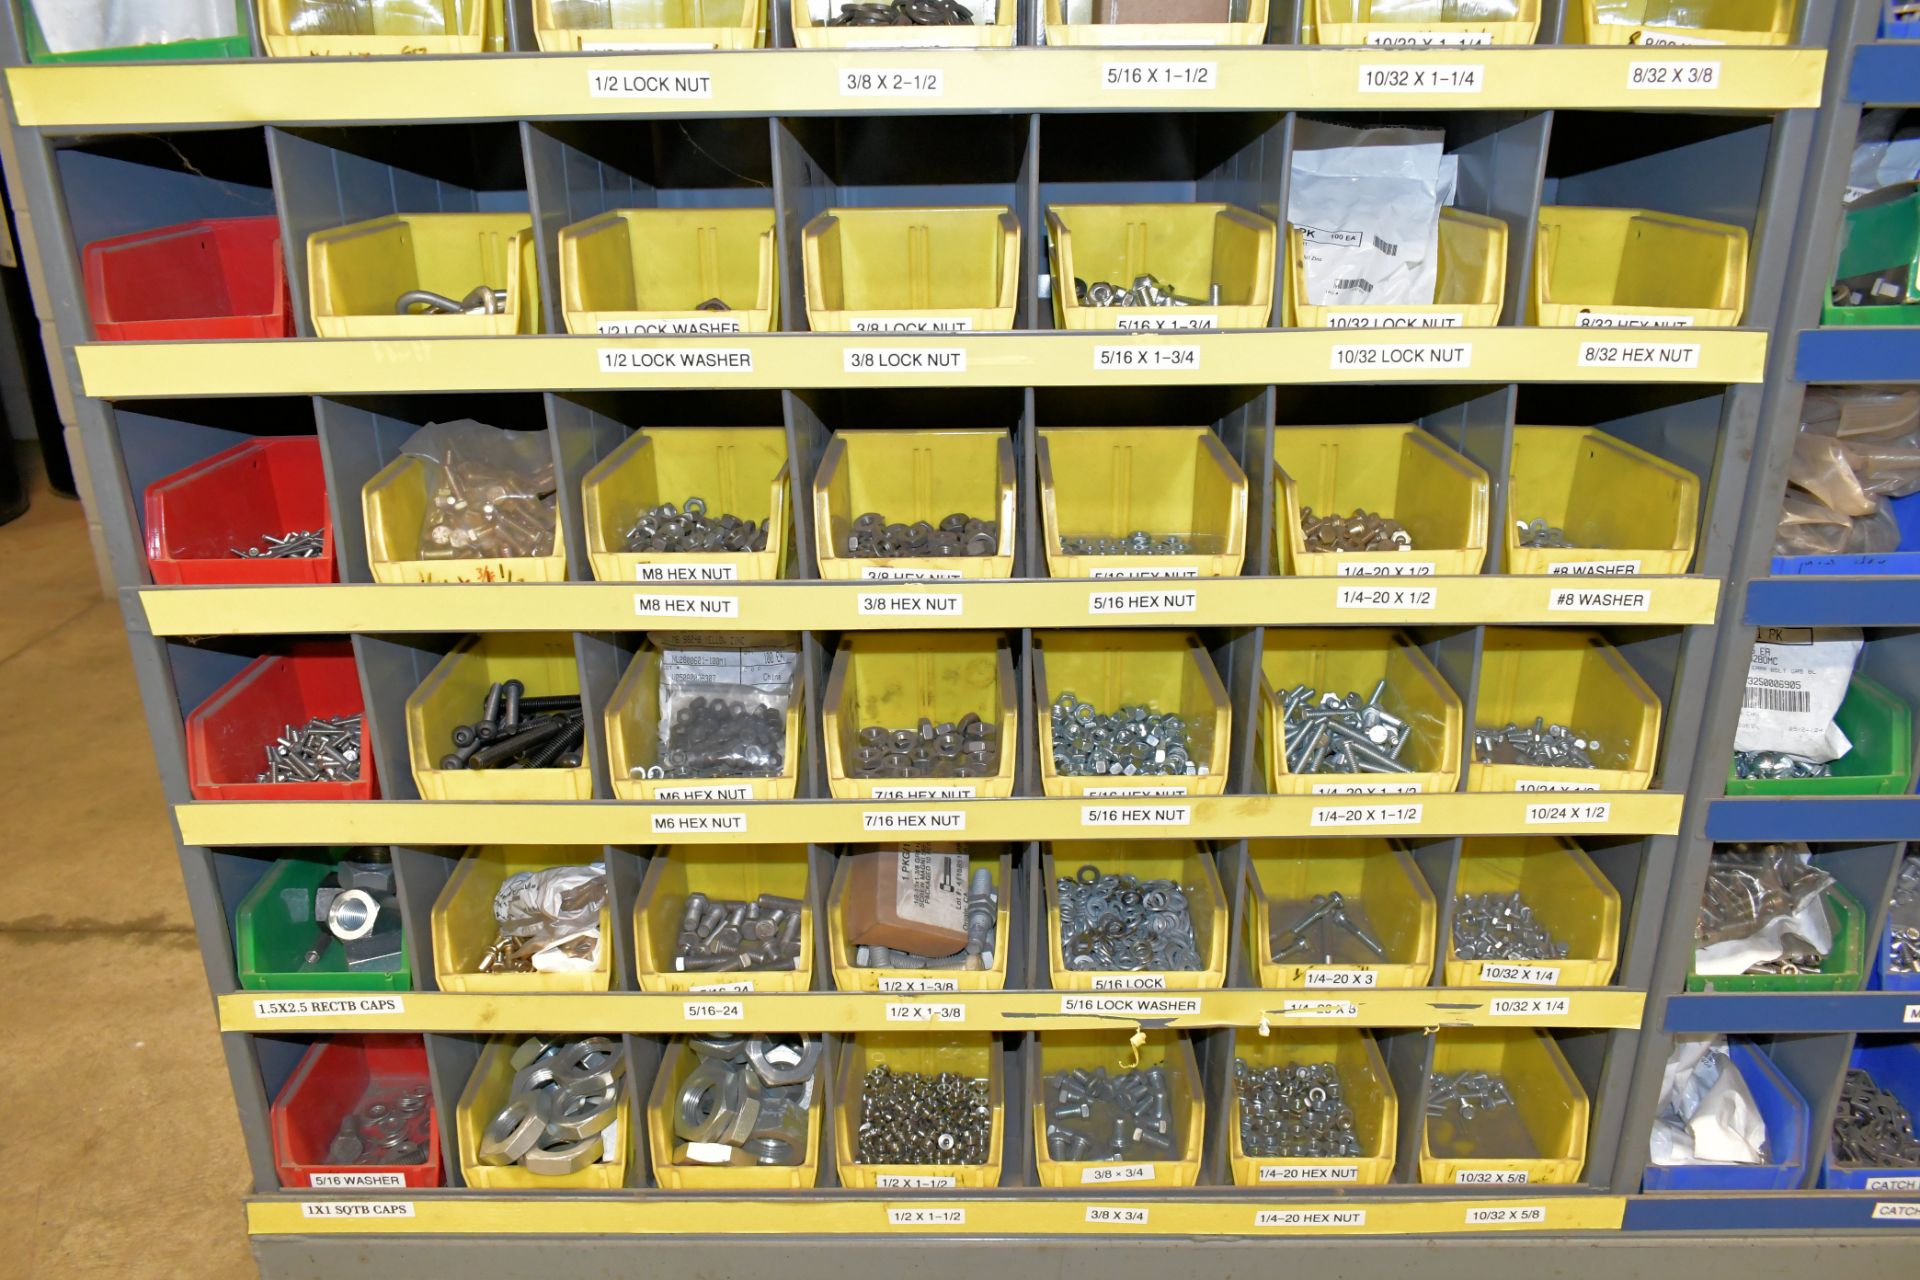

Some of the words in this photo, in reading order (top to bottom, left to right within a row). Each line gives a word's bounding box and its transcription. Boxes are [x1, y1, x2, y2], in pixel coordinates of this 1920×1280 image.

[1107, 68, 1142, 83] 5/16
[1147, 69, 1158, 83] X
[1165, 68, 1208, 83] 1-1/2
[1366, 71, 1409, 86] 10/32
[1414, 71, 1425, 86] X
[1432, 71, 1474, 86] 1-1/4
[1633, 67, 1667, 83] 8/32
[1672, 68, 1683, 82] X
[1688, 67, 1713, 83] 3/8
[595, 76, 618, 91] 1/2
[623, 76, 670, 91] LOCK
[675, 77, 710, 92] NUT
[847, 74, 871, 90] 3/8
[877, 75, 888, 89] X
[893, 75, 937, 90] 2-1/2
[605, 354, 627, 367] 1/2
[632, 353, 676, 367] LOCK
[680, 353, 750, 367] WASHER
[851, 353, 874, 367] 3/8
[879, 353, 922, 366] LOCK
[928, 353, 960, 366] NUT
[1101, 351, 1132, 364] 5/16
[1138, 351, 1147, 363] X
[1154, 351, 1194, 364] 1-3/4
[1338, 350, 1376, 363] 10/32
[1382, 349, 1424, 363] LOCK
[1431, 349, 1464, 362] NUT
[1586, 348, 1618, 361] 8/32
[1622, 349, 1655, 361] HEX
[1659, 349, 1692, 362] NUT
[643, 568, 663, 580] M8
[668, 568, 697, 580] HEX
[702, 568, 731, 580] NUT
[1573, 565, 1635, 575] WASHER
[1094, 597, 1124, 609] 5/16
[1128, 596, 1159, 608] HEX
[1164, 595, 1195, 607] NUT
[1343, 592, 1390, 604] 1/4-20
[1394, 592, 1404, 604] X
[1410, 592, 1431, 604] 1/2
[1557, 594, 1574, 606] #8
[1578, 594, 1644, 606] WASHER
[640, 599, 660, 611] M8
[666, 600, 695, 612] HEX
[701, 601, 731, 612] NUT
[864, 598, 886, 610] 3/8
[891, 598, 921, 610] HEX
[926, 599, 957, 610] NUT
[1769, 628, 1783, 641] PK
[660, 791, 679, 800] M6
[684, 790, 713, 800] HEX
[718, 789, 746, 800] NUT
[1089, 811, 1117, 821] 5/16
[1122, 811, 1151, 820] HEX
[1155, 810, 1185, 820] NUT
[1318, 810, 1362, 821] 1/4-20
[1367, 810, 1375, 820] X
[1381, 808, 1416, 820] 1-1/2
[1532, 808, 1566, 819] 10/24
[1571, 808, 1580, 818] X
[1586, 807, 1605, 818] 1/2
[655, 818, 674, 829] M6
[679, 818, 707, 828] HEX
[712, 817, 741, 828] NUT
[865, 816, 893, 826] 7/16
[898, 816, 926, 826] HEX
[931, 816, 960, 826] NUT
[1308, 973, 1348, 984] 1/4-20
[1353, 975, 1361, 984] X
[1365, 975, 1373, 984] 3
[1486, 968, 1518, 979] 10/32
[1522, 971, 1531, 980] X
[1535, 970, 1553, 981] 1/4
[884, 981, 902, 991] 1/2
[907, 982, 915, 991] X
[1096, 979, 1122, 989] 5/16
[1127, 979, 1163, 988] LOCK
[259, 1001, 308, 1014] 1.5X2.5
[312, 1000, 356, 1012] RECTB
[361, 999, 395, 1010] CAPS
[689, 1006, 738, 1016] 5/16-24
[1066, 1000, 1093, 1010] 5/16
[1097, 1000, 1133, 1011] LOCK
[1138, 1000, 1196, 1011] WASHER
[1495, 1001, 1527, 1012] 10/32
[1532, 1001, 1541, 1011] X
[1547, 1001, 1564, 1011] 1/4
[891, 1007, 909, 1017] 1/2
[914, 1007, 922, 1017] X
[1094, 1170, 1112, 1179] 3/8
[1125, 1168, 1143, 1178] 3/4
[1260, 1169, 1298, 1178] 1/4-20
[1302, 1169, 1328, 1178] HEX
[1331, 1169, 1357, 1178] NUT
[1460, 1173, 1491, 1183] 10/32
[1496, 1173, 1503, 1183] X
[1507, 1173, 1526, 1183] 5/8
[316, 1176, 341, 1186] 5/16
[345, 1176, 400, 1186] WASHER
[883, 1178, 899, 1187] 1/2
[904, 1178, 911, 1188] X
[916, 1179, 948, 1188] 1-1/2
[1871, 1180, 1915, 1191] CATCH
[309, 1205, 331, 1215] 1X1
[336, 1204, 370, 1215] SQTB
[374, 1204, 407, 1214] CAPS
[1091, 1210, 1109, 1219] 3/8
[1113, 1211, 1121, 1220] X
[1125, 1211, 1143, 1220] 3/4
[895, 1212, 912, 1221] 1/2
[916, 1212, 924, 1221] X
[929, 1212, 961, 1221] 1-1/2
[1260, 1214, 1299, 1223] 1/4-20
[1304, 1214, 1329, 1223] HEX
[1333, 1214, 1360, 1223] NUT
[1474, 1211, 1505, 1221] 10/32
[1510, 1210, 1518, 1219] X
[1521, 1210, 1540, 1220] 5/8
